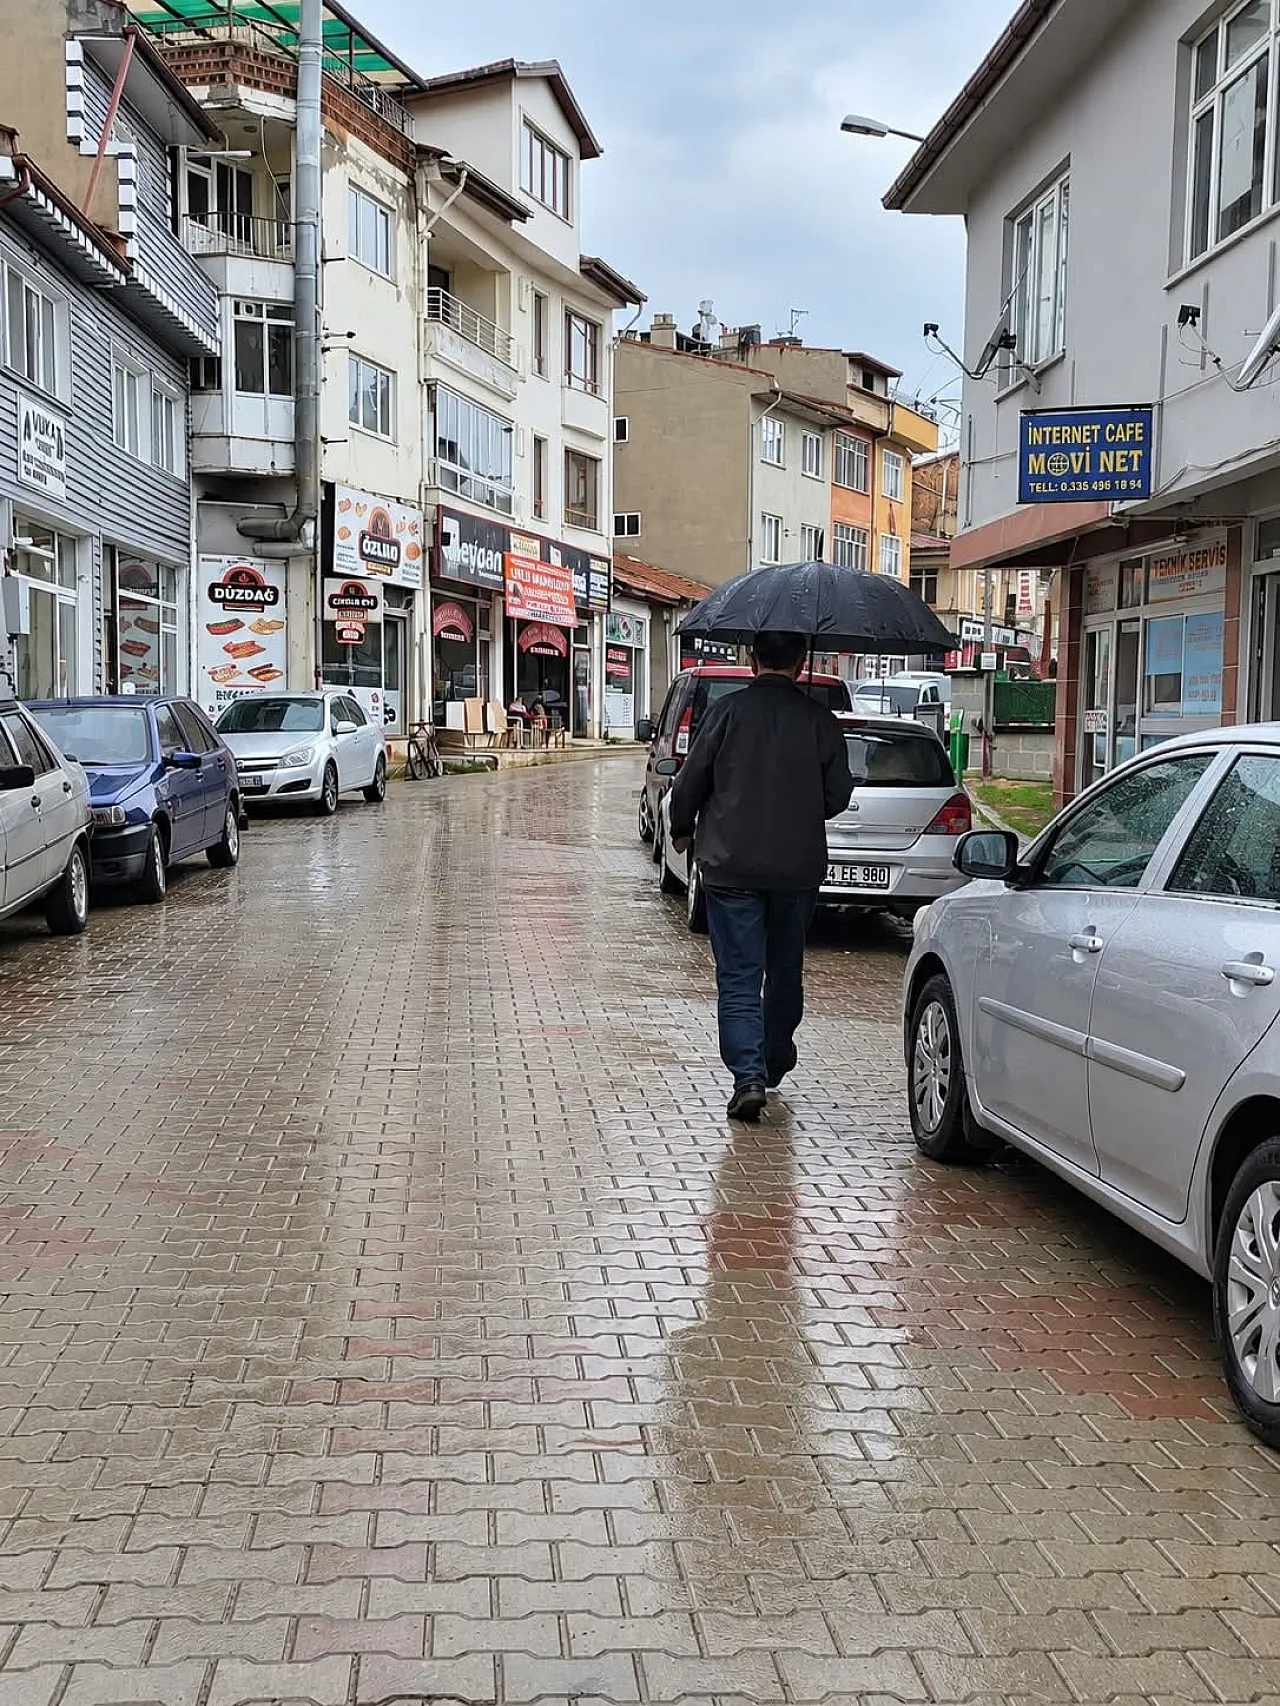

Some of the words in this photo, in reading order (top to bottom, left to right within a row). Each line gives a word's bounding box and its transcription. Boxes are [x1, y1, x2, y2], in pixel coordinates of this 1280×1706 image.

[1028, 422, 1101, 445] İNTERNET
[1105, 422, 1145, 443] CAFE
[1099, 449, 1143, 473] NET
[214, 585, 275, 602] DÜZDAĞ
[841, 866, 858, 881] EE
[862, 867, 886, 882] 980
